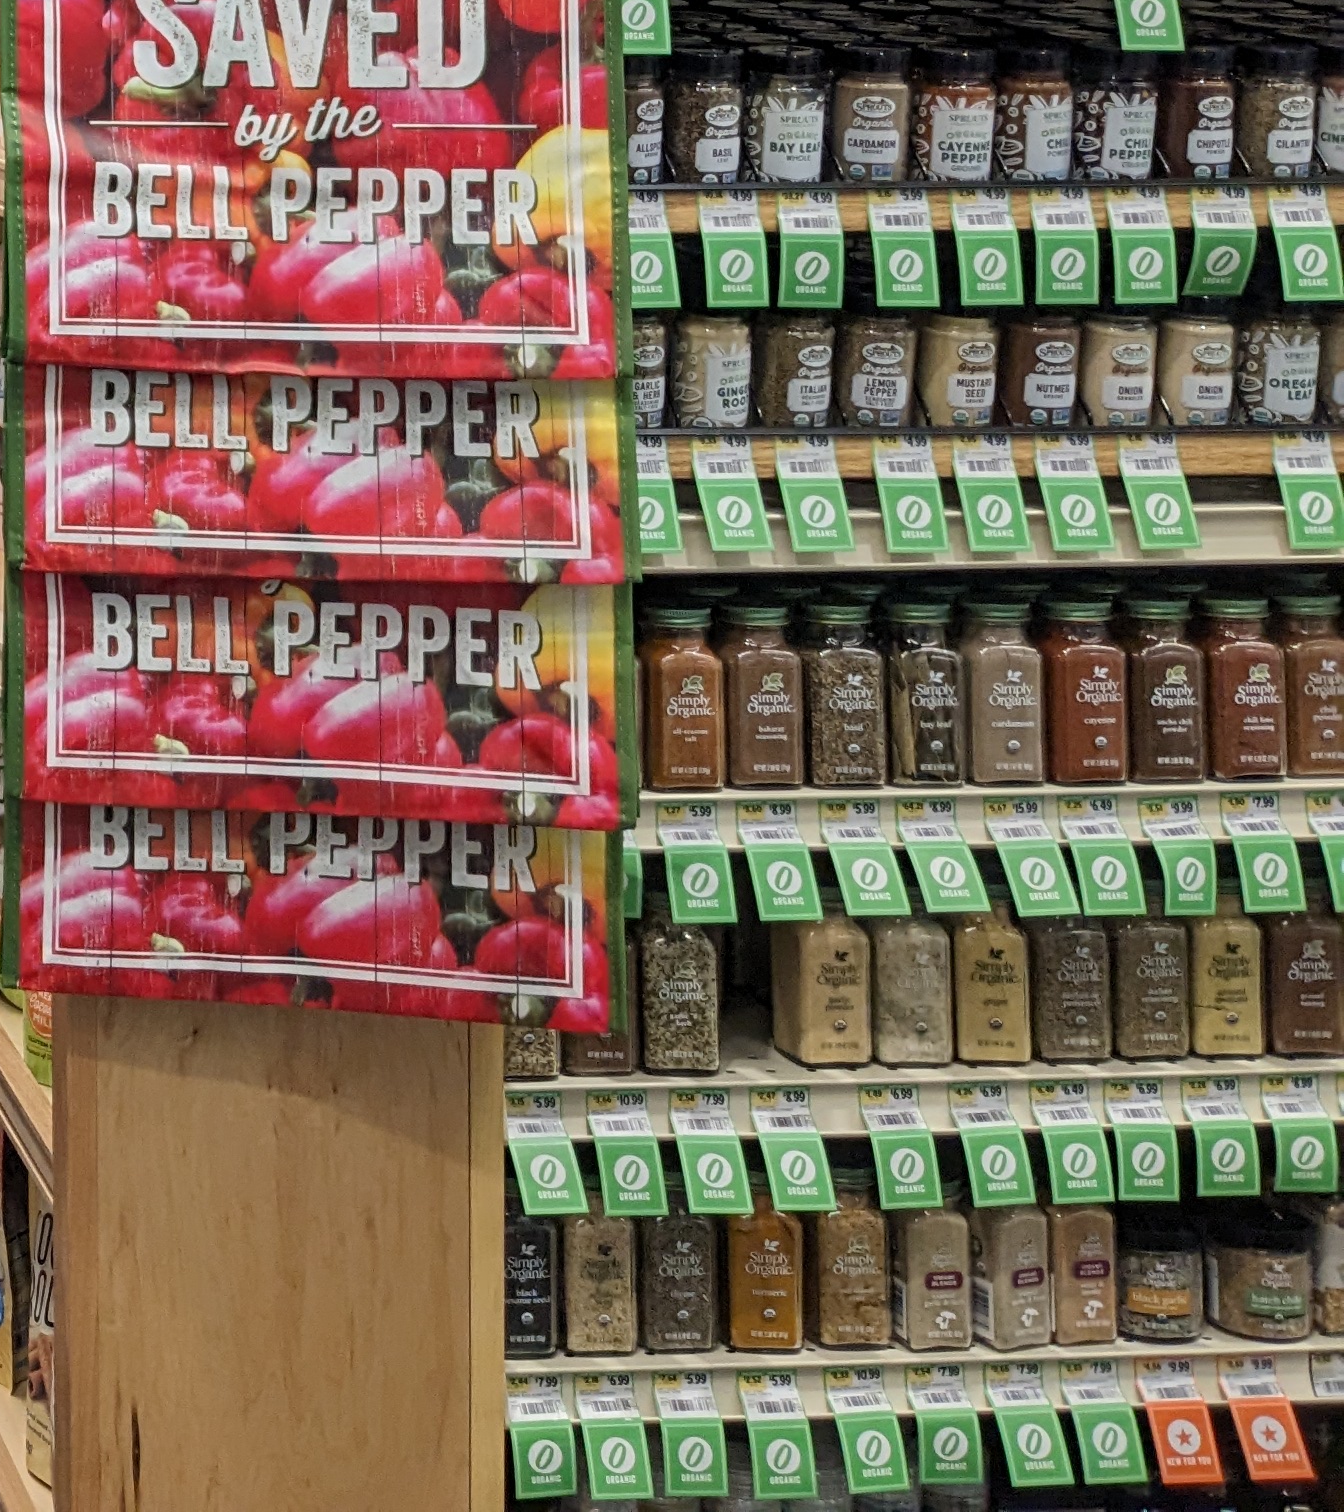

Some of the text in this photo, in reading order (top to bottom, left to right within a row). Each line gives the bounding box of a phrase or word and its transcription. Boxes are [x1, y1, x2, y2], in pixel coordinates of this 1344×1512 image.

[234, 97, 382, 162] by the
[712, 148, 732, 158] BASIL
[770, 141, 797, 154] BAY
[941, 152, 988, 164] PEPPER
[93, 161, 539, 247] BELL PEPPER
[634, 379, 661, 390] GARLIC
[866, 379, 897, 388] LEMON
[864, 387, 898, 398] PEPPER
[965, 389, 986, 398] SEED
[91, 369, 540, 459] BELL PEPPER
[91, 592, 544, 690] BELL PEPPER
[670, 692, 710, 708] Simply
[750, 692, 790, 707] Simply
[747, 702, 796, 716] Organic
[88, 805, 536, 892] BELL PEPPER
[687, 899, 719, 908] ORGANIC
[750, 1252, 789, 1266] Simply
[1167, 1457, 1212, 1466] NEW FOR YOU
